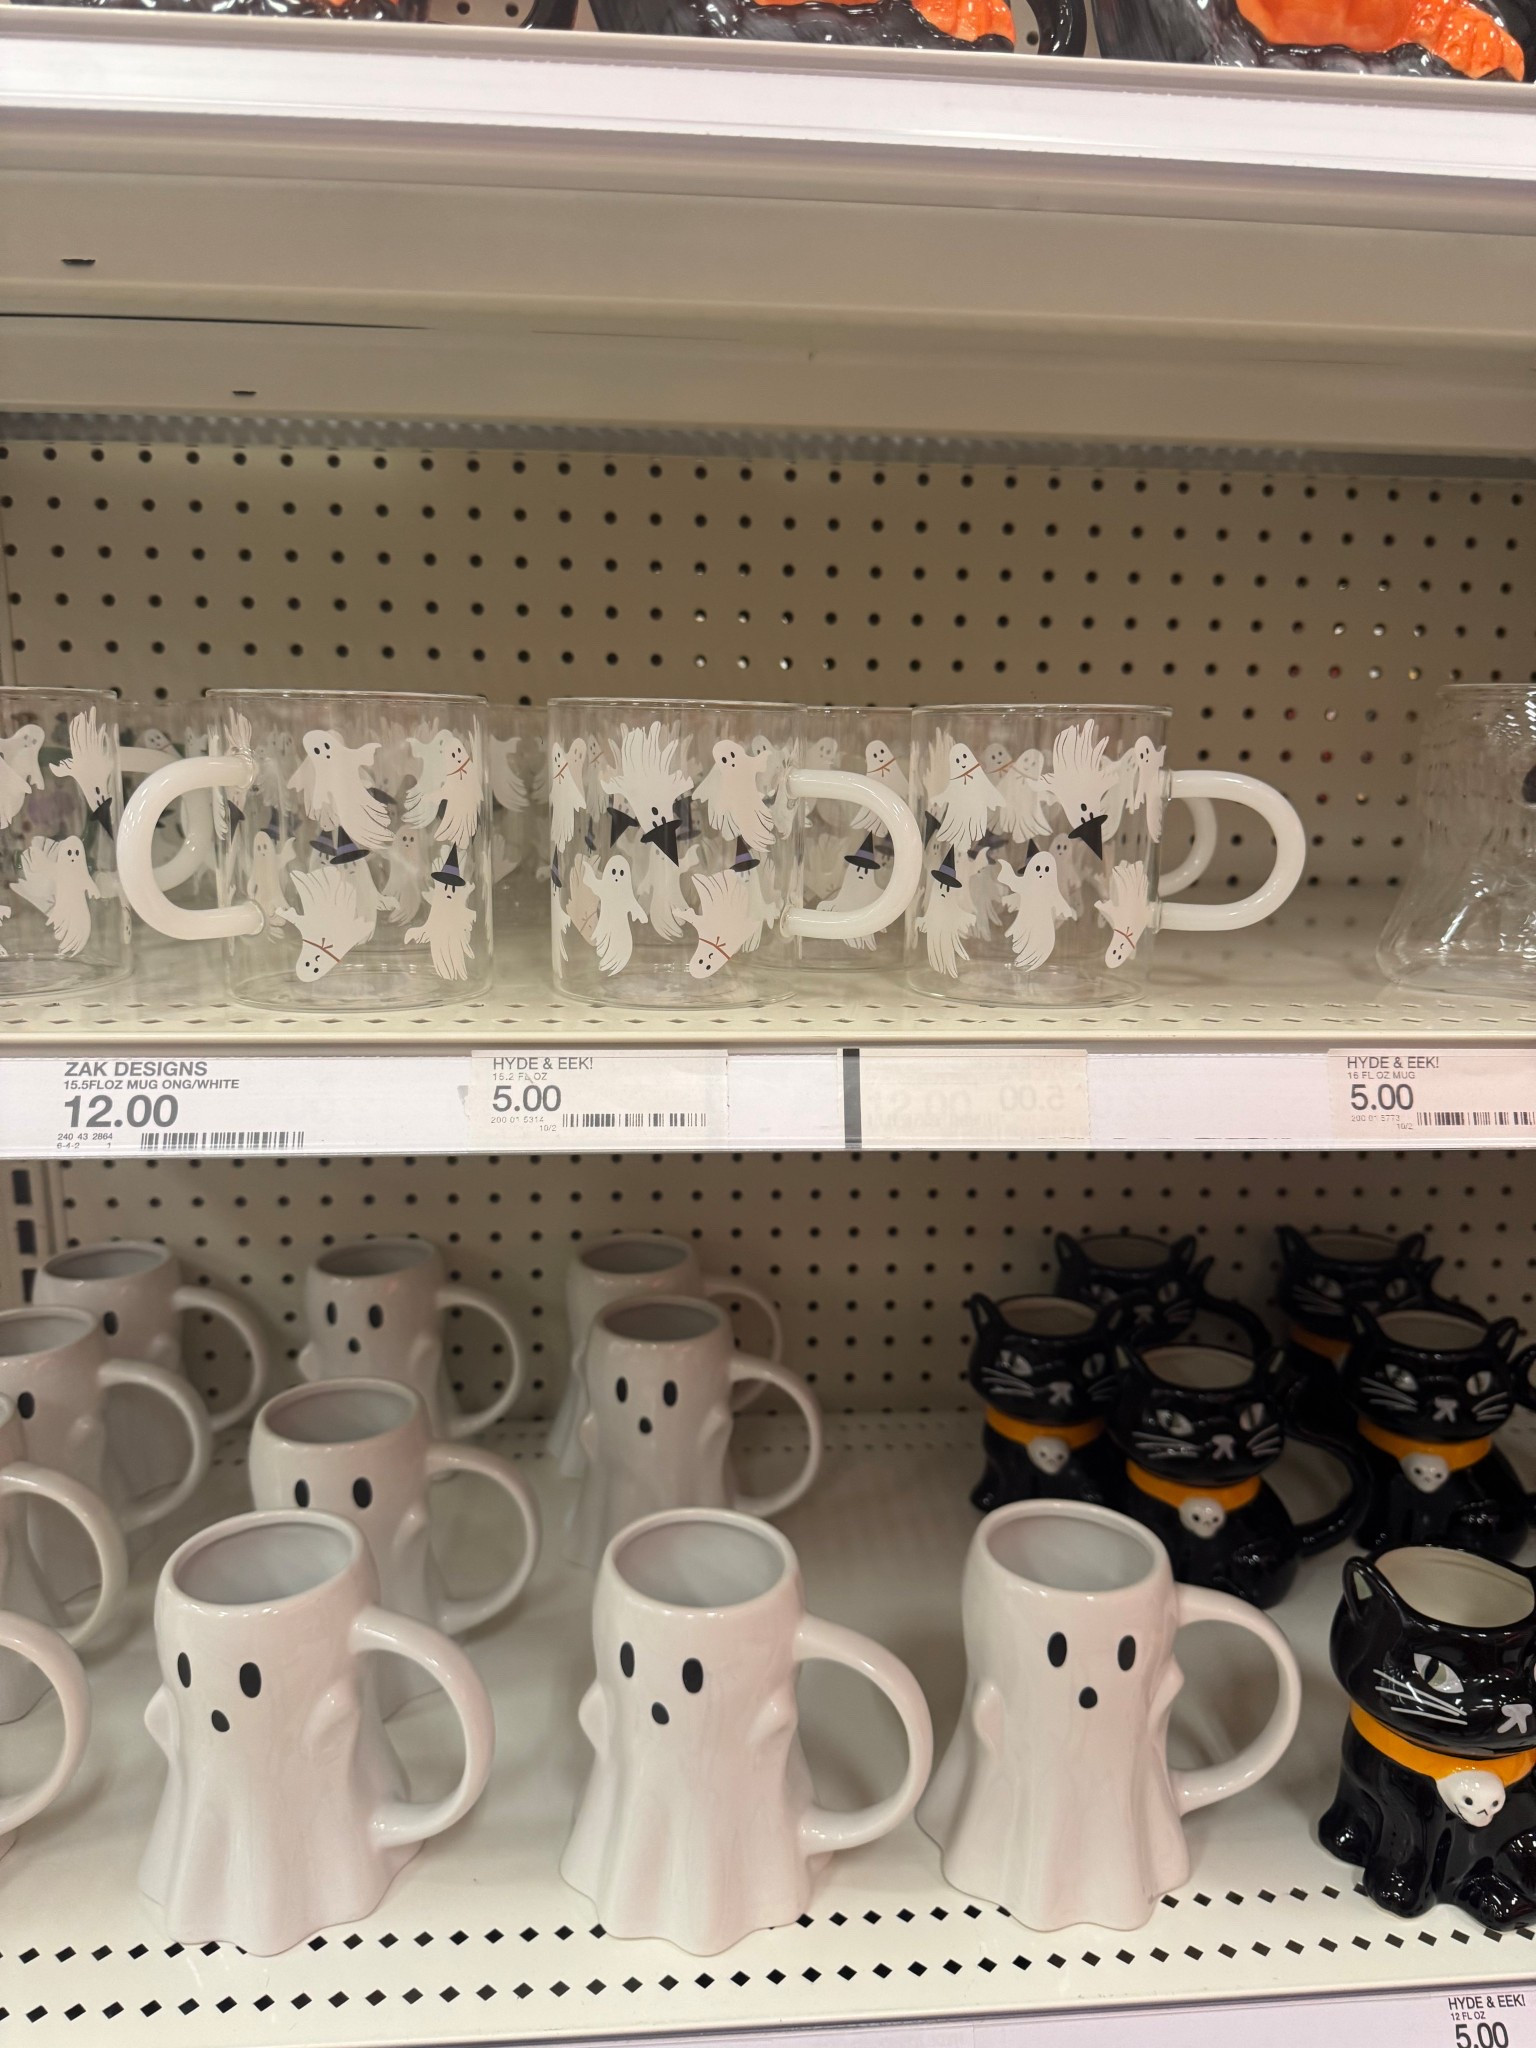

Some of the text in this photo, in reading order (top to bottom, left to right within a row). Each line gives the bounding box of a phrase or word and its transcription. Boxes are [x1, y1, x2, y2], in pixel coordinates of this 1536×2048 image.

[64, 1061, 208, 1076] ZAK DESIGNS
[493, 1057, 593, 1070] HYDE & EEK!
[1347, 1057, 1439, 1069] HYDE & EEK!
[534, 1072, 547, 1081] OZ
[1362, 1072, 1374, 1080] FL
[1376, 1072, 1390, 1080] OZ
[1392, 1072, 1416, 1080] MUG
[63, 1079, 240, 1090] 15.5FLOZ MUG ONG/WHITE
[492, 1085, 561, 1112] 5.00
[1351, 1084, 1414, 1110] 5.00
[64, 1094, 178, 1128] 12.00
[57, 1132, 113, 1141] 240 43 2864
[1448, 1994, 1526, 2010] HYDE & EEK!
[1450, 2011, 1486, 2021] 12 FL OZ
[1455, 2022, 1510, 2048] 5.00
